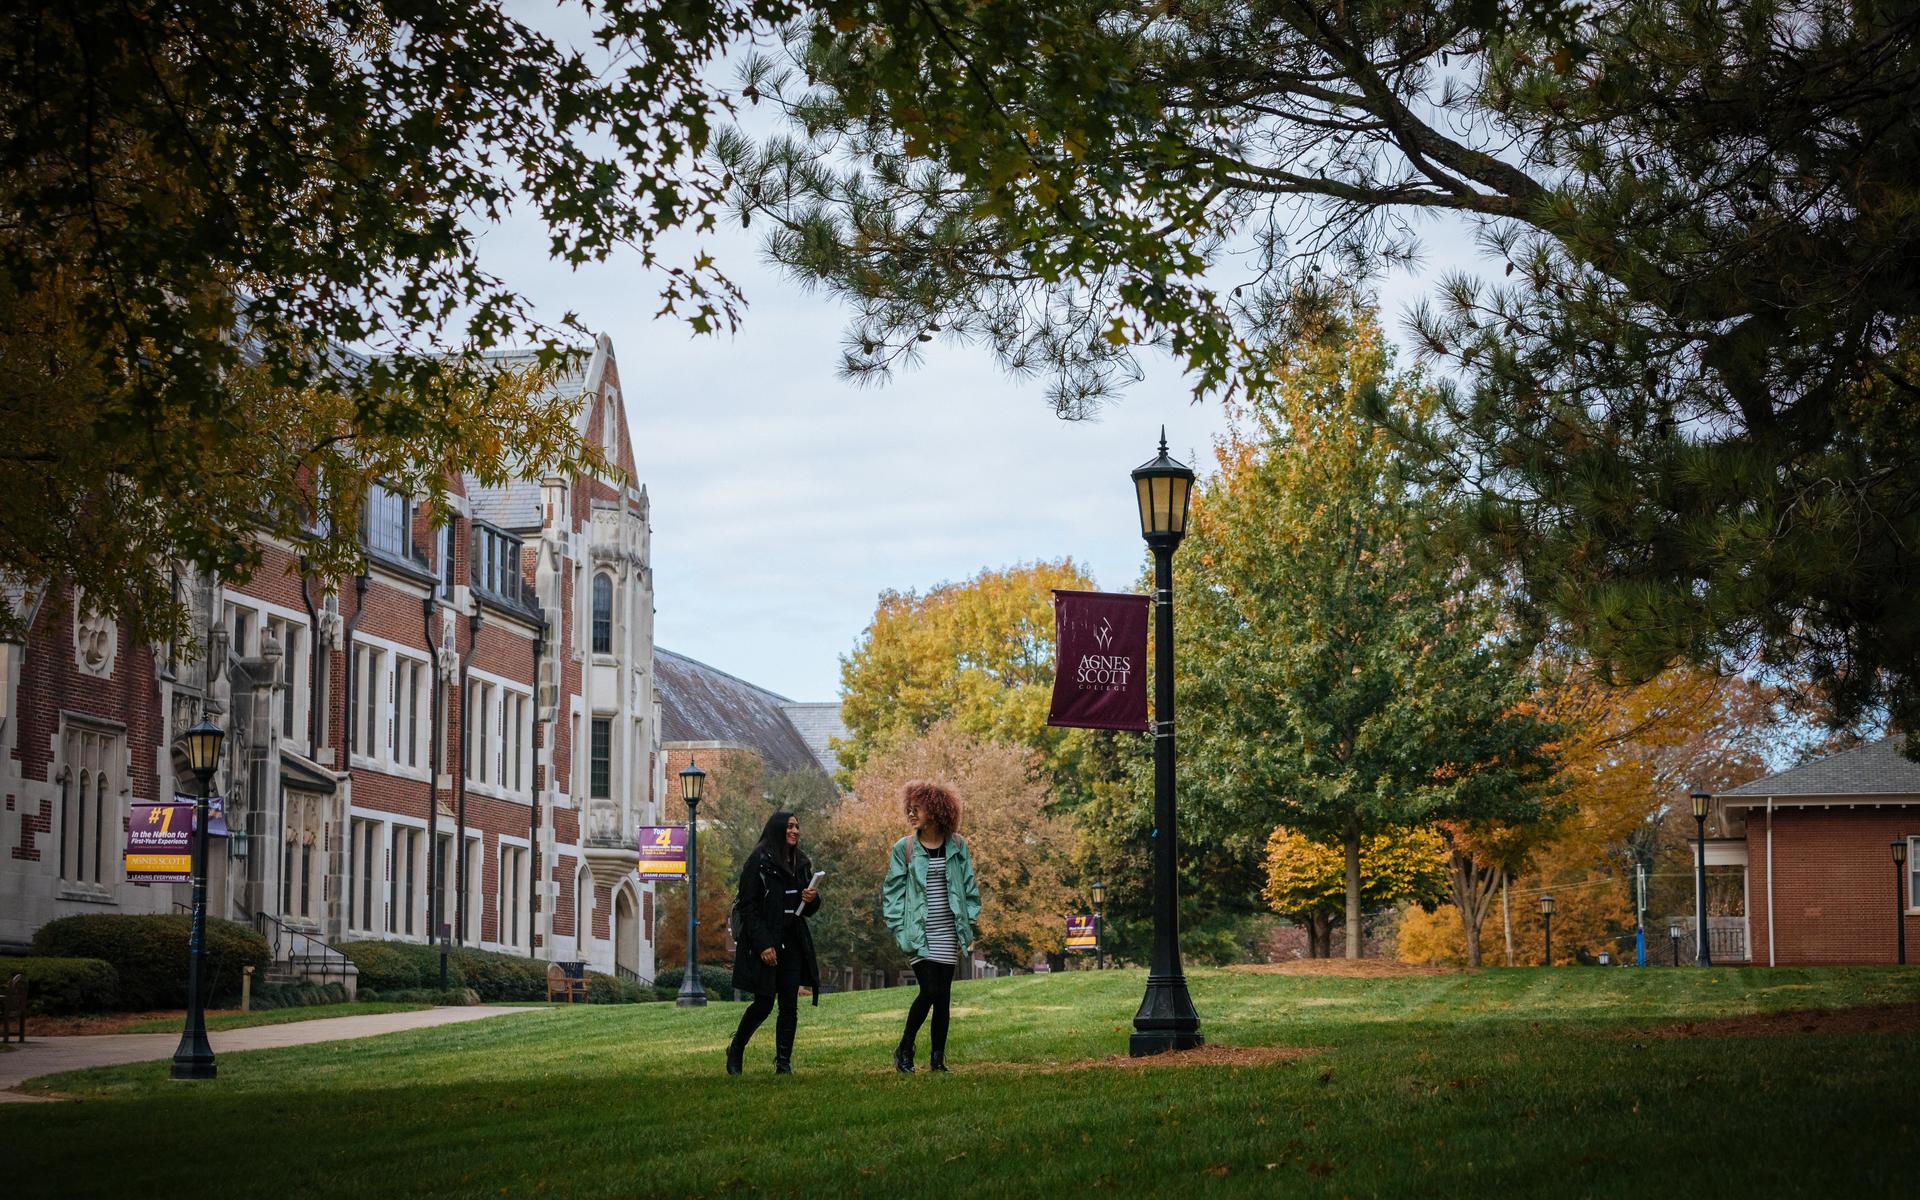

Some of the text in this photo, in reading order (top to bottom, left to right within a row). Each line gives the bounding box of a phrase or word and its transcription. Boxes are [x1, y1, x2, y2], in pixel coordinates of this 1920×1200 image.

[1078, 654, 1130, 670] AGNES
[1077, 669, 1130, 684] SCOTT
[148, 807, 174, 833] #1
[656, 828, 672, 847] 4
[131, 857, 185, 865] AGNES SCOTT
